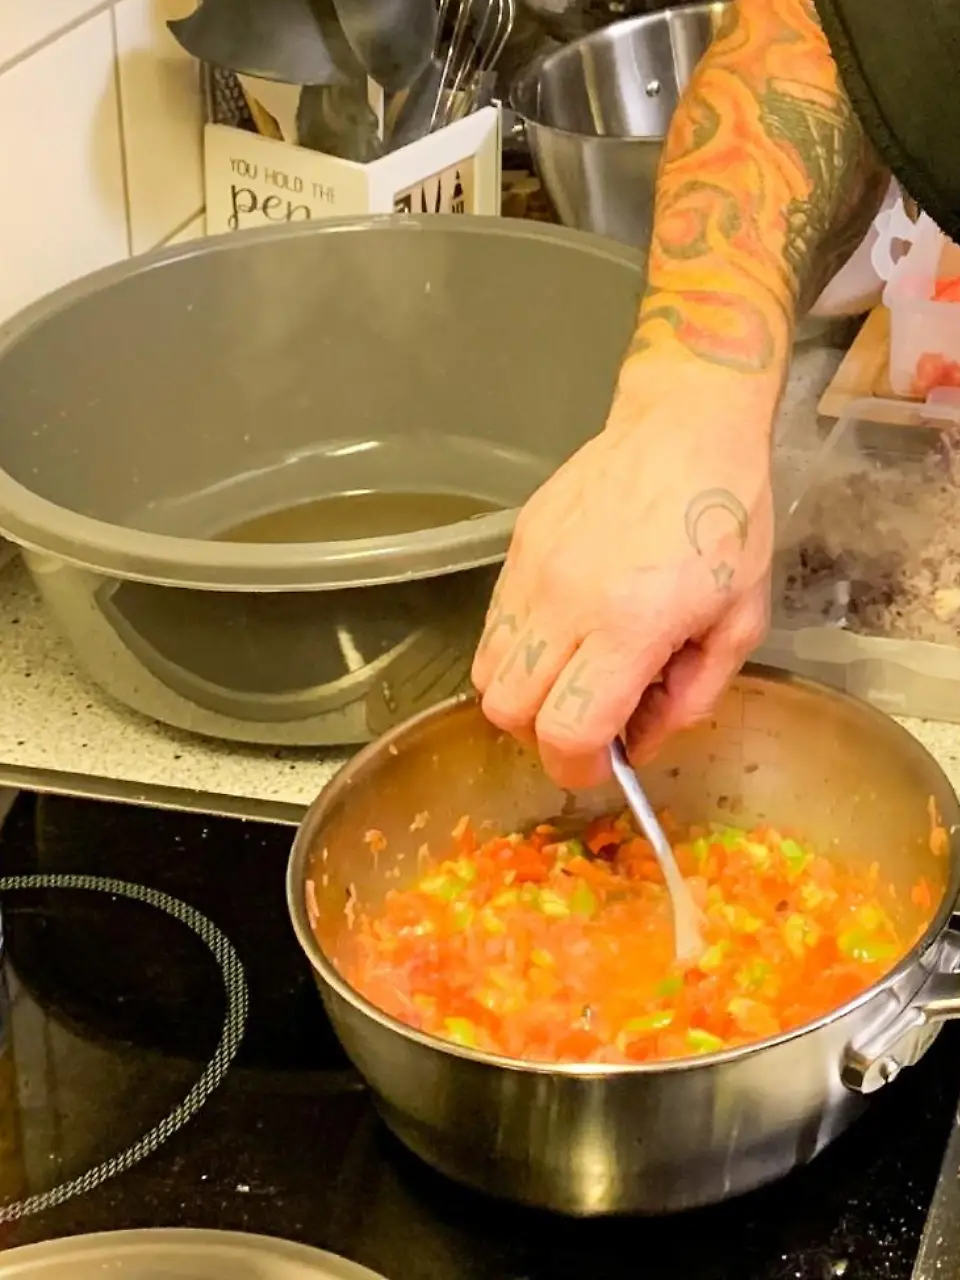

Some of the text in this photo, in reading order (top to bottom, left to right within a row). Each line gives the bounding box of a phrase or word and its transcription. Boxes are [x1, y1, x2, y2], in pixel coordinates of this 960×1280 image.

[229, 156, 336, 204] YOU HOLD THE
[227, 184, 312, 230] pen
